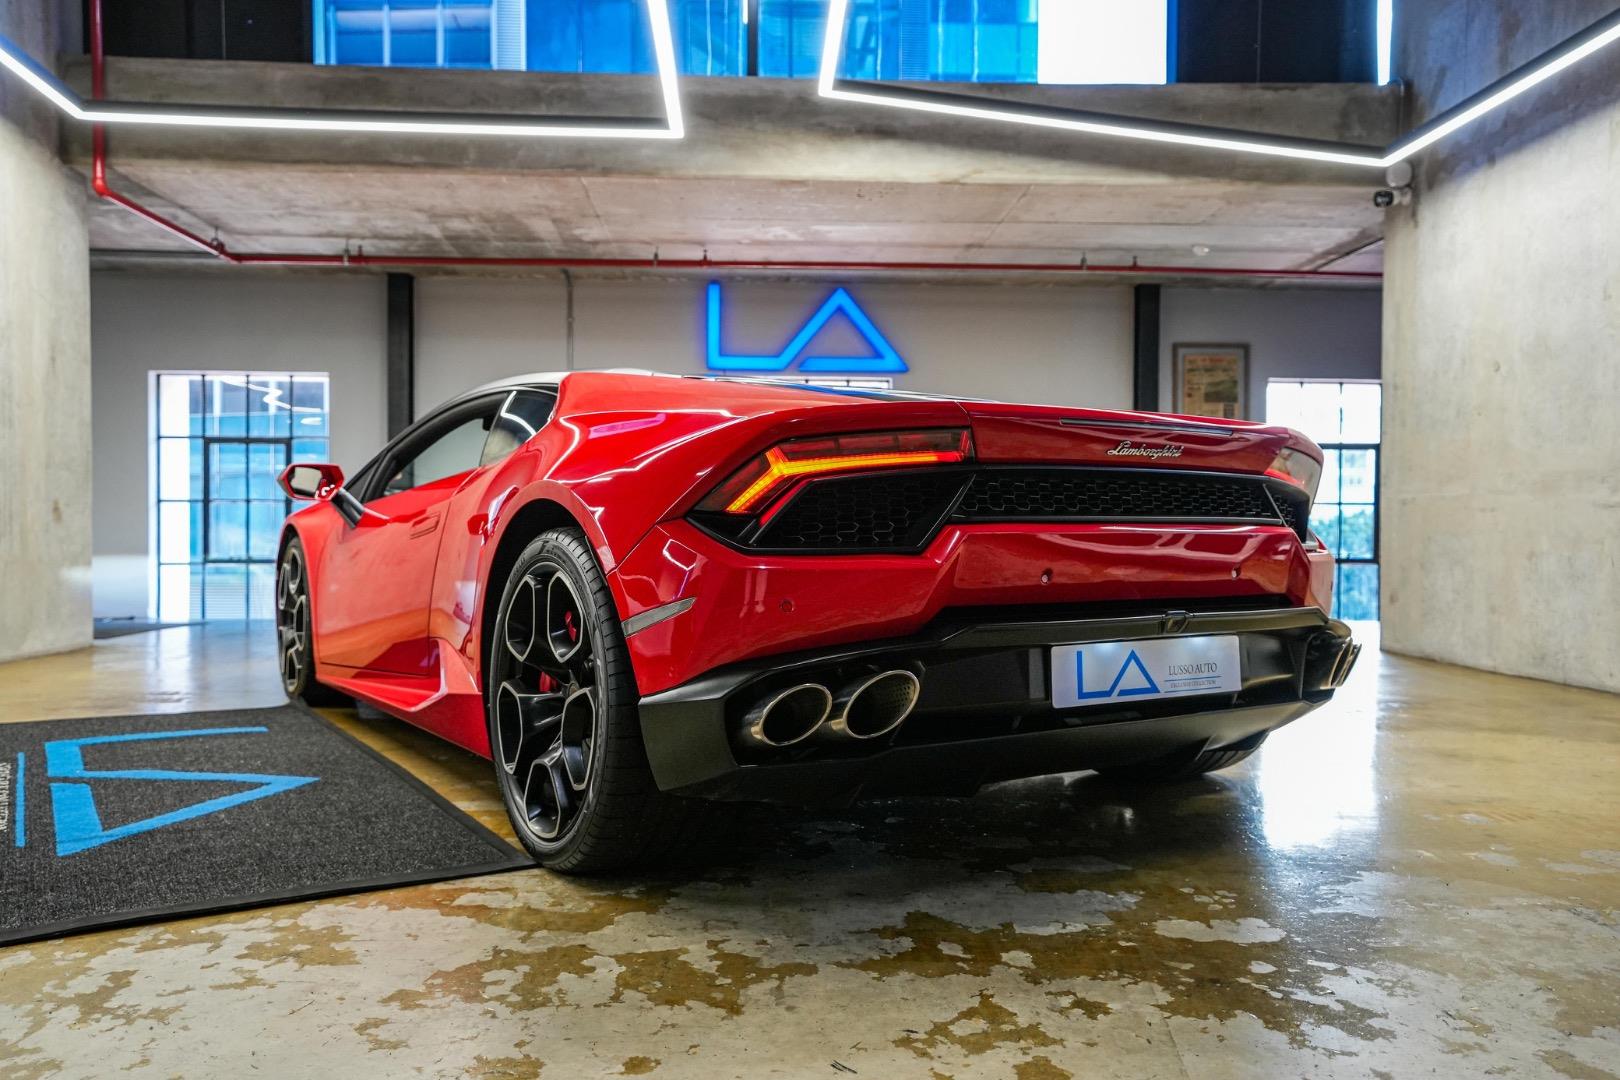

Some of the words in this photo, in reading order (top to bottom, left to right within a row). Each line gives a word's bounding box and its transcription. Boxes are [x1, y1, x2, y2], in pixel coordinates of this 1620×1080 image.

[707, 283, 909, 372] LA
[1107, 441, 1184, 460] Lamborghini
[1076, 649, 1160, 700] LA
[1168, 664, 1194, 676] LUSSO
[1194, 662, 1218, 674] AUTO
